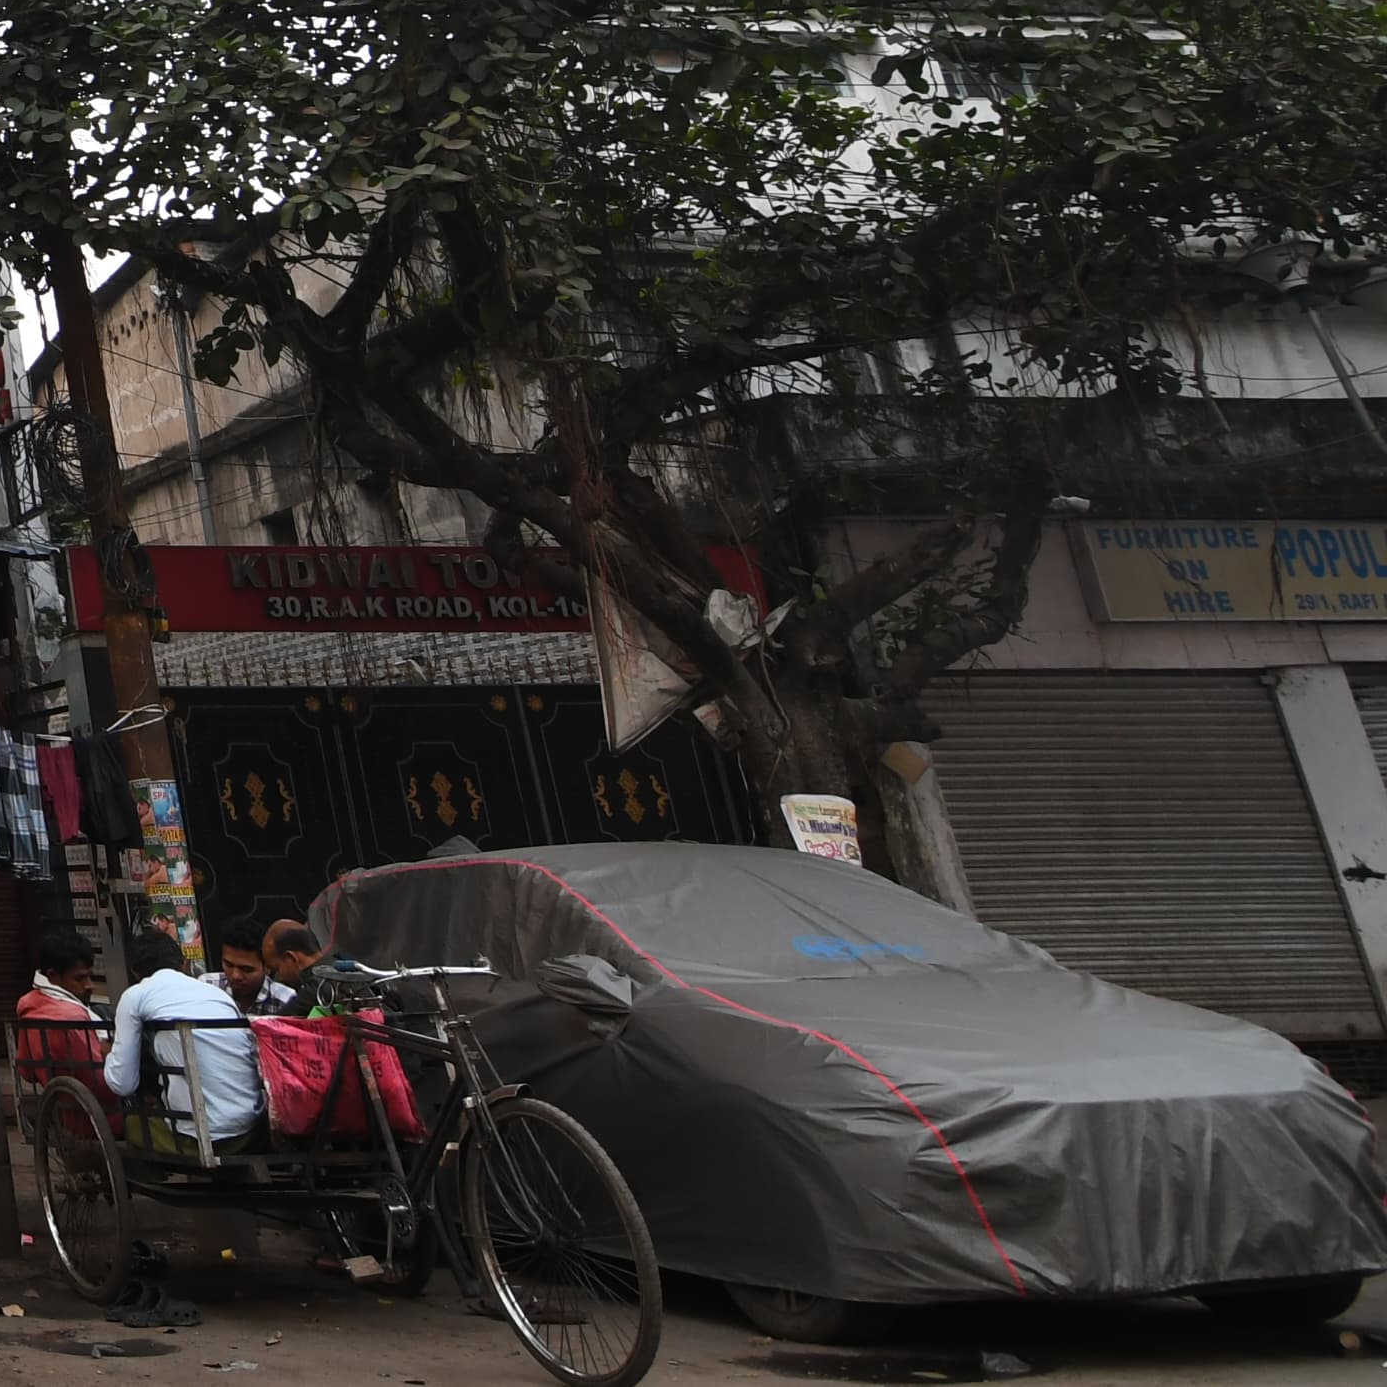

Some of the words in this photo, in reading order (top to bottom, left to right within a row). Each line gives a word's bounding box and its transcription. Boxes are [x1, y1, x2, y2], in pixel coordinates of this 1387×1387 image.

[1098, 527, 1259, 550] FURNITURE
[1276, 527, 1387, 579] POPUL
[229, 552, 420, 590] KIDWAI
[1167, 560, 1211, 581] ON
[396, 597, 482, 623] ROAD,
[1163, 591, 1235, 613] HIRE
[1339, 593, 1379, 611] RAFI
